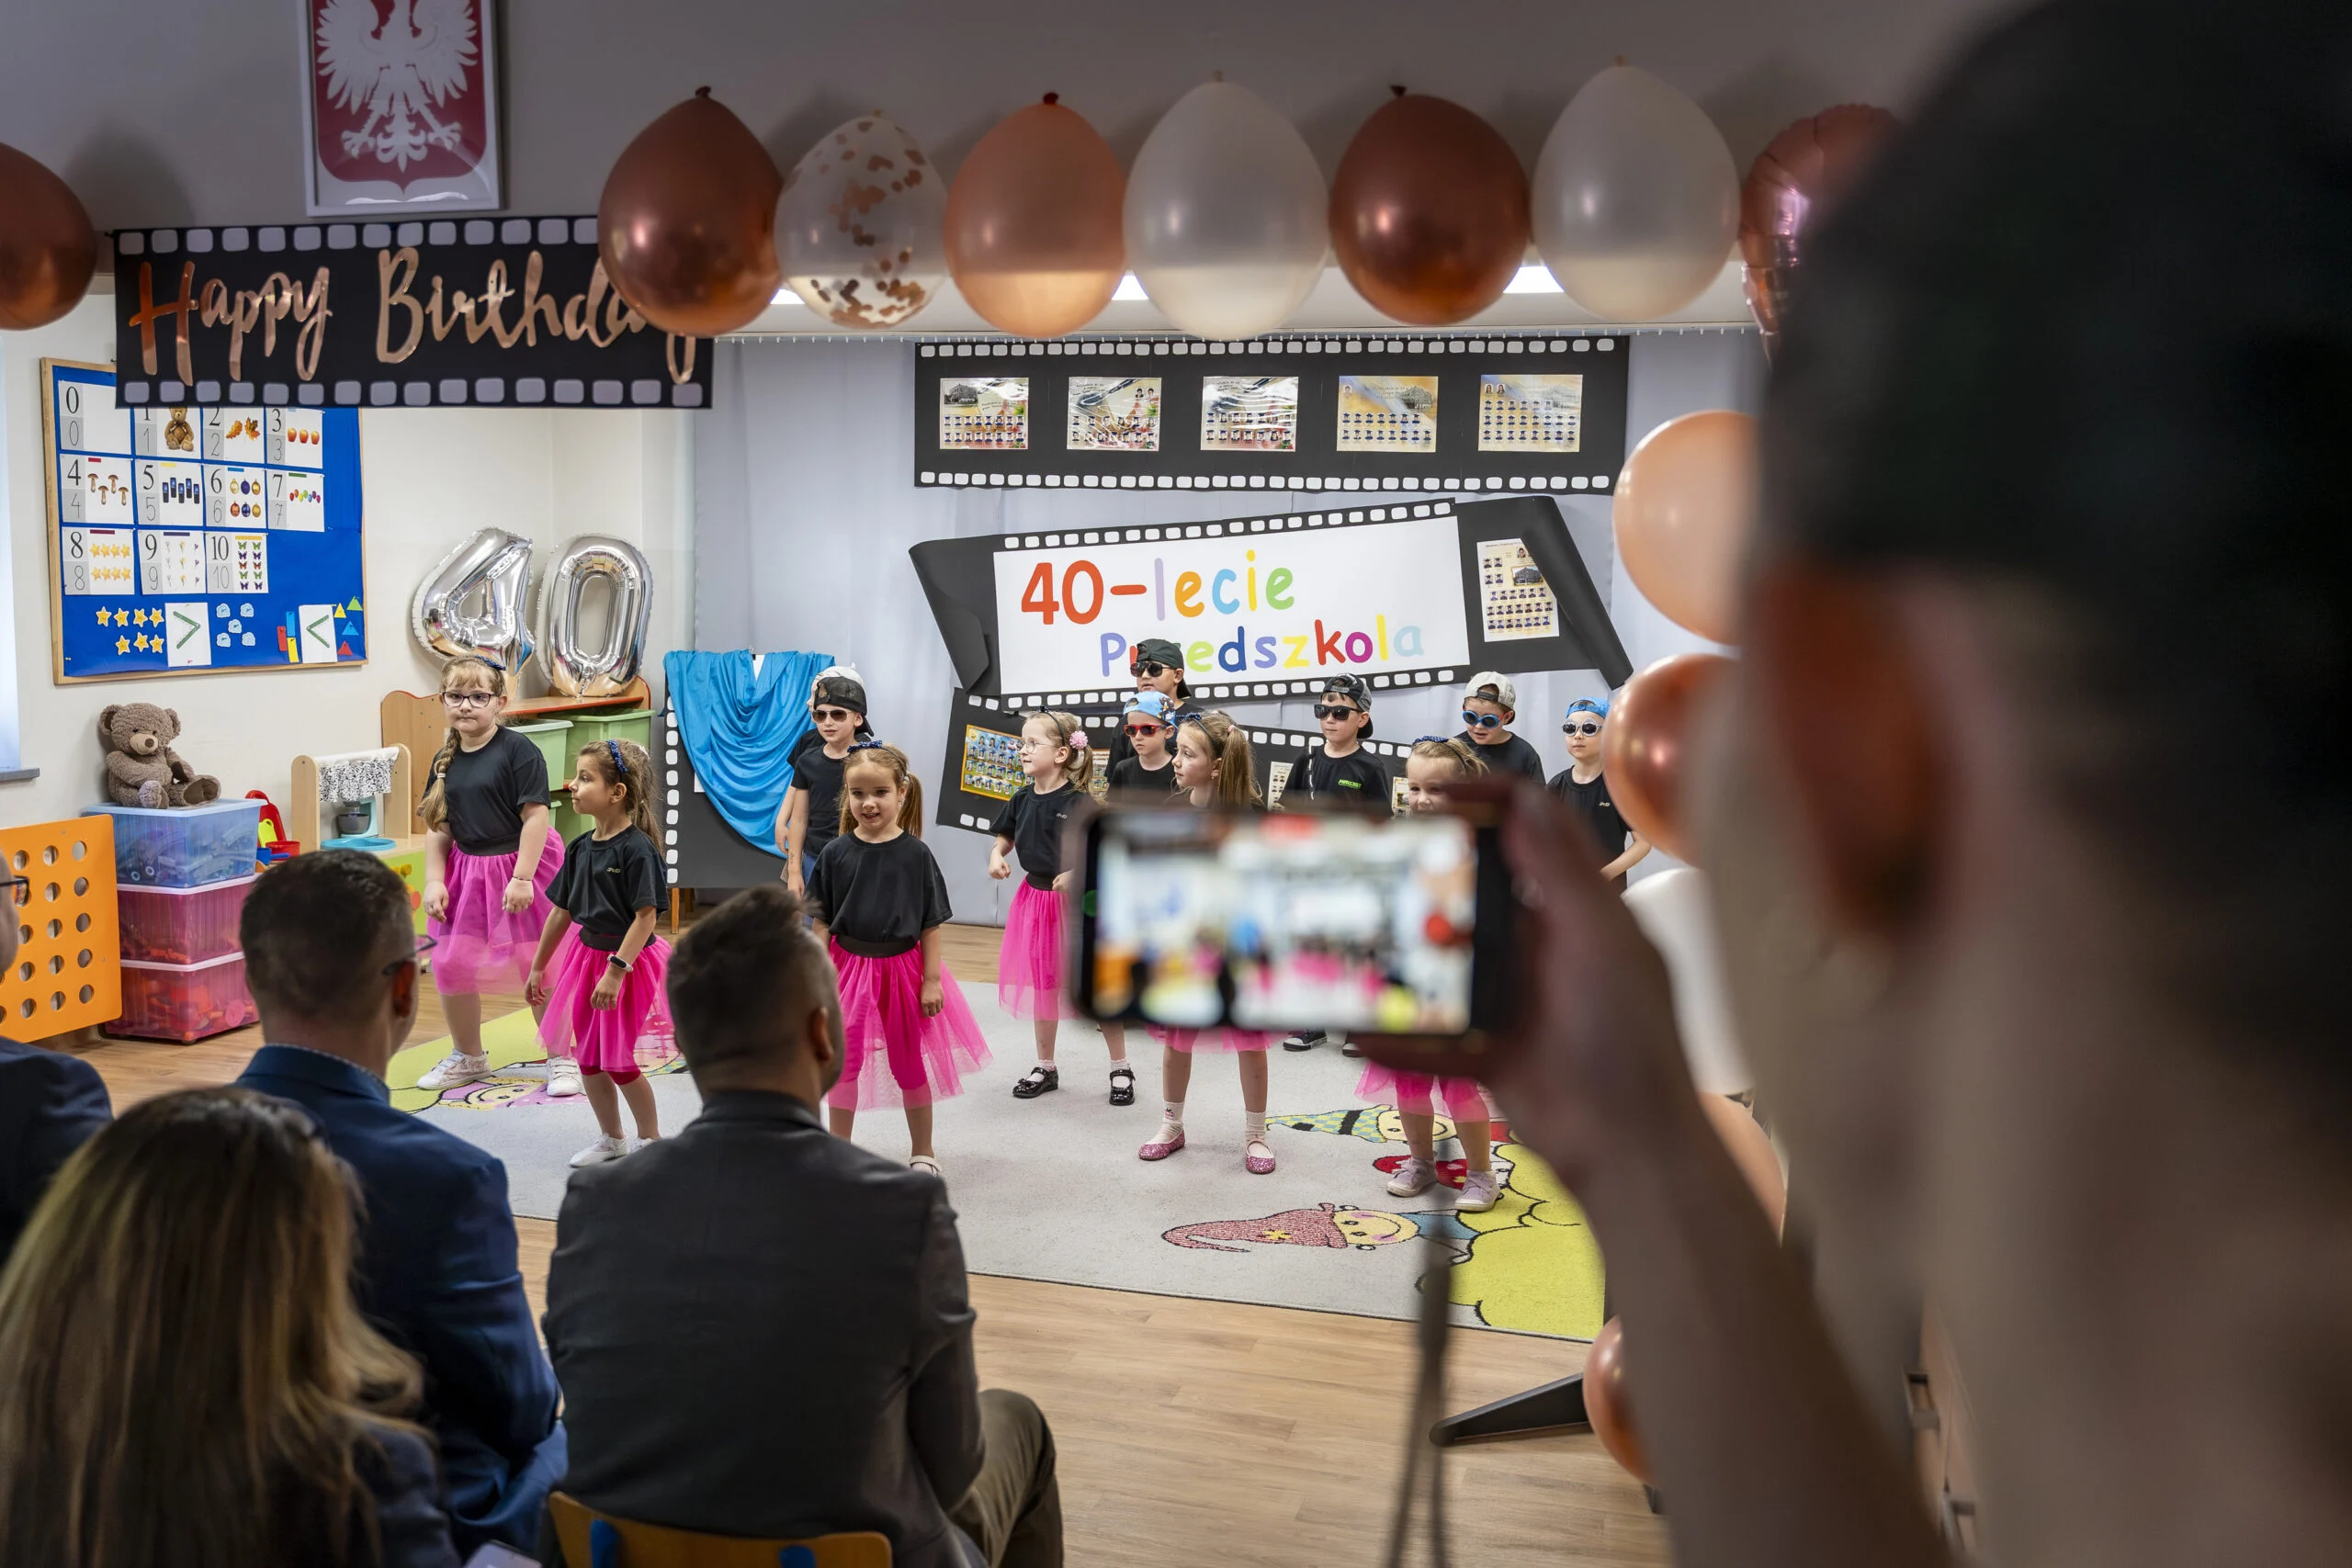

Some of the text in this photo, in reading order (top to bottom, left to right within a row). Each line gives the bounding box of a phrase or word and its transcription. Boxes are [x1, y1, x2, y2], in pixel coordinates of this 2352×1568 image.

[129, 261, 334, 387] Happy
[65, 386, 79, 413] 0
[209, 407, 220, 426] 2
[271, 408, 282, 433] 3
[69, 421, 79, 446] 0
[143, 428, 151, 453] 1
[210, 433, 220, 457] 2
[273, 438, 282, 461] 3
[67, 459, 82, 486] 4
[143, 465, 154, 491] 5
[210, 468, 222, 494] 6
[272, 474, 283, 498] 7
[71, 493, 81, 519] 4
[145, 496, 156, 521] 5
[213, 500, 222, 523] 6
[275, 502, 284, 526] 7
[71, 531, 84, 558] 8
[145, 534, 157, 559] 9
[211, 536, 229, 561] 10
[74, 565, 85, 591] 8
[149, 566, 159, 591] 9
[213, 566, 229, 589] 10
[1021, 549, 1295, 625] 40-lecie
[413, 527, 653, 698] 40
[1100, 615, 1424, 677] Pedszkola
